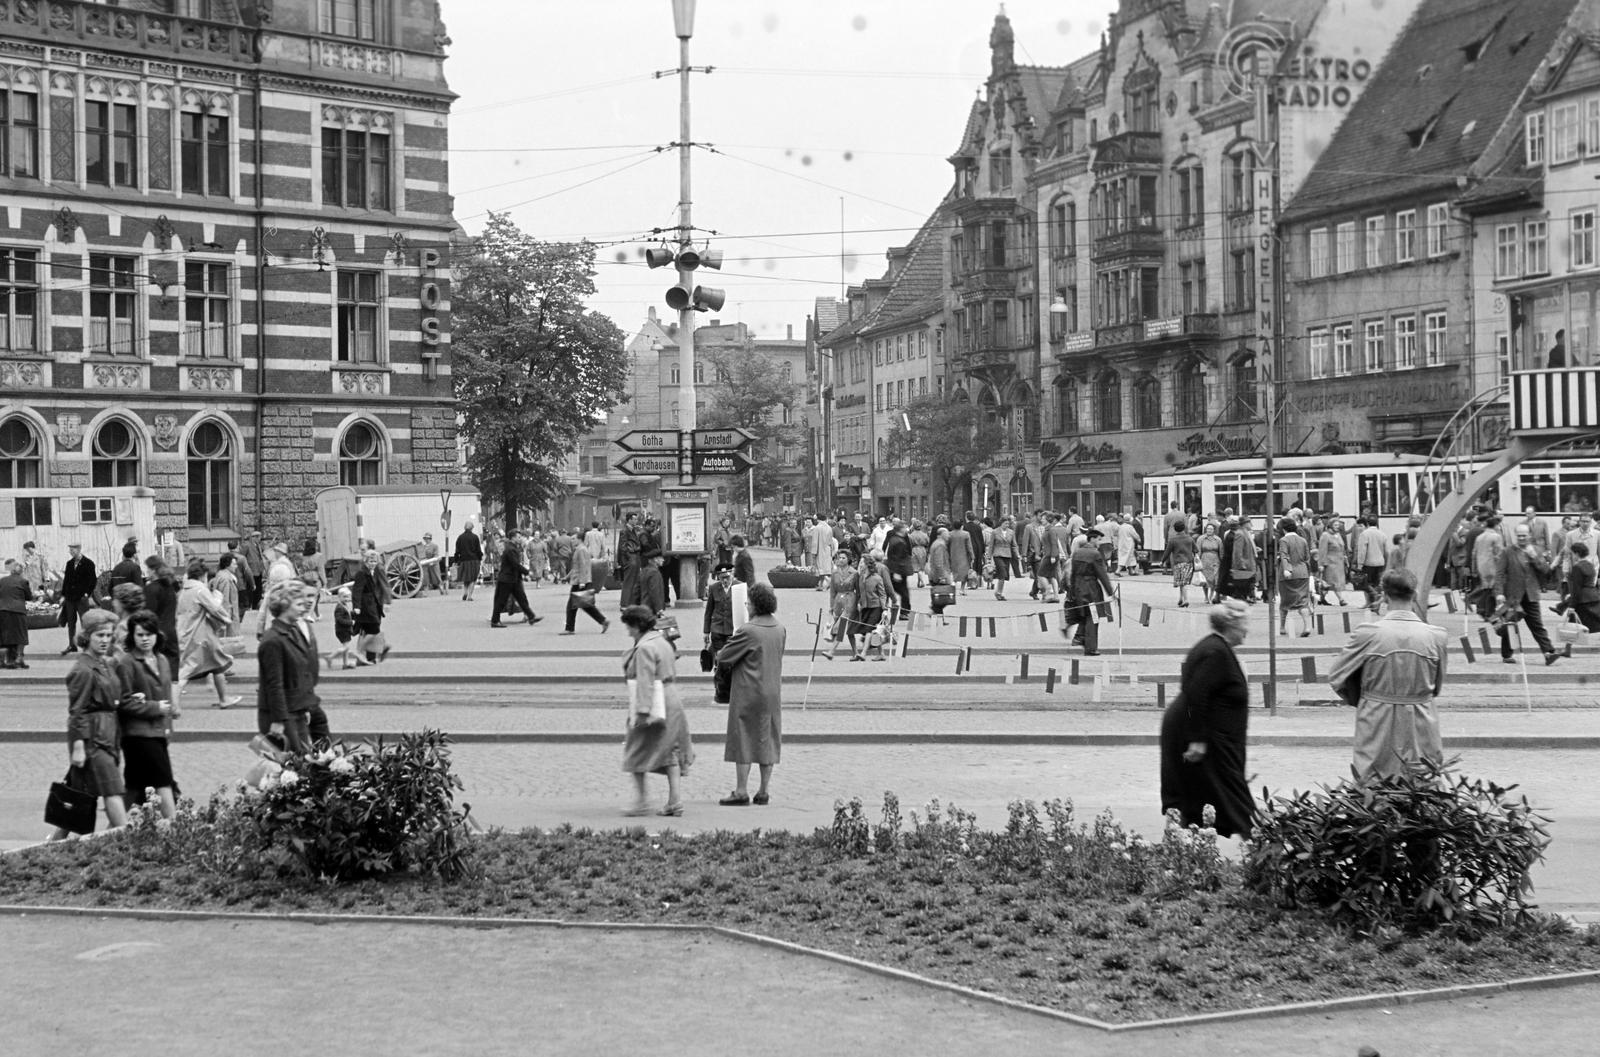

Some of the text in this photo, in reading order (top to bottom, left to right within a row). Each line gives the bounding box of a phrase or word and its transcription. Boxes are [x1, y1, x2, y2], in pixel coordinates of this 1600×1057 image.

[1274, 85, 1351, 108] RADIO
[420, 249, 442, 380] POST
[641, 434, 664, 447] Gotha
[703, 433, 732, 445] Arnstadt
[633, 457, 676, 470] Nordhausen
[703, 457, 734, 466] Autobahn
